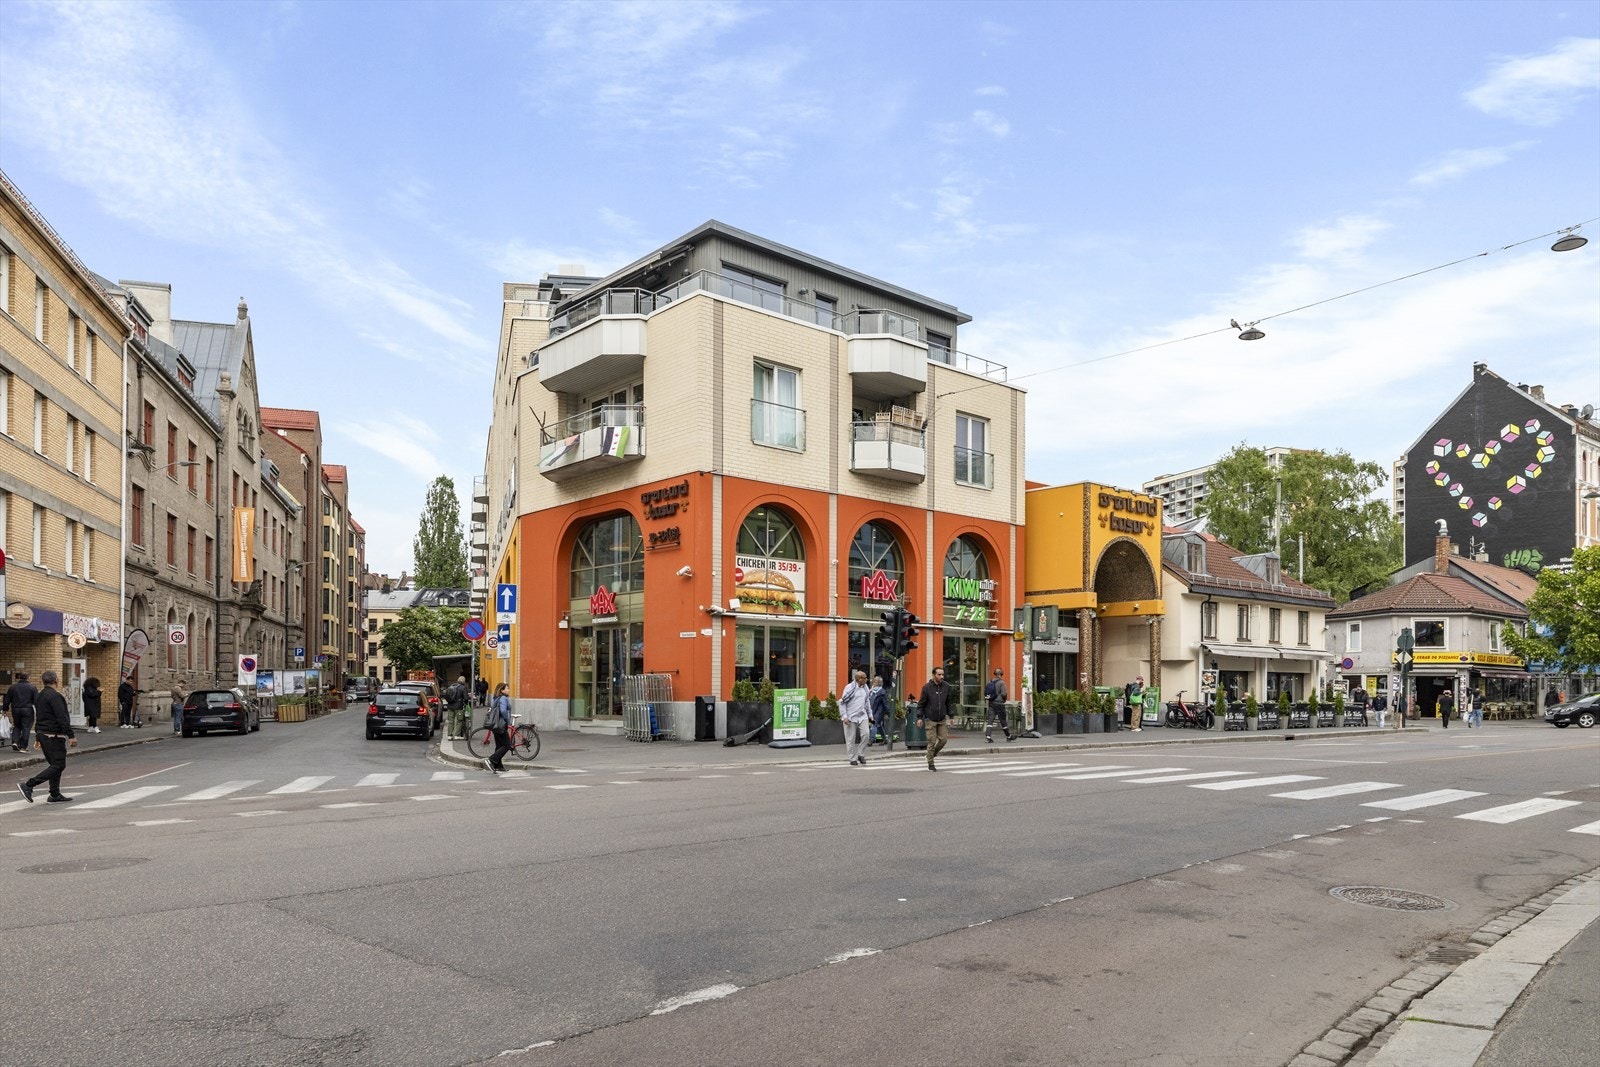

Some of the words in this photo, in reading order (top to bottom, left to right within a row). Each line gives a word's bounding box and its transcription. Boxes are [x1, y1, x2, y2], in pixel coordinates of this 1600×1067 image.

[737, 558, 765, 569] CHICKEN
[862, 569, 898, 601] MAX
[946, 576, 979, 600] KIWI
[980, 579, 994, 590] mini
[590, 585, 616, 615] MAX
[296, 648, 303, 656] P
[783, 704, 800, 718] 17%
